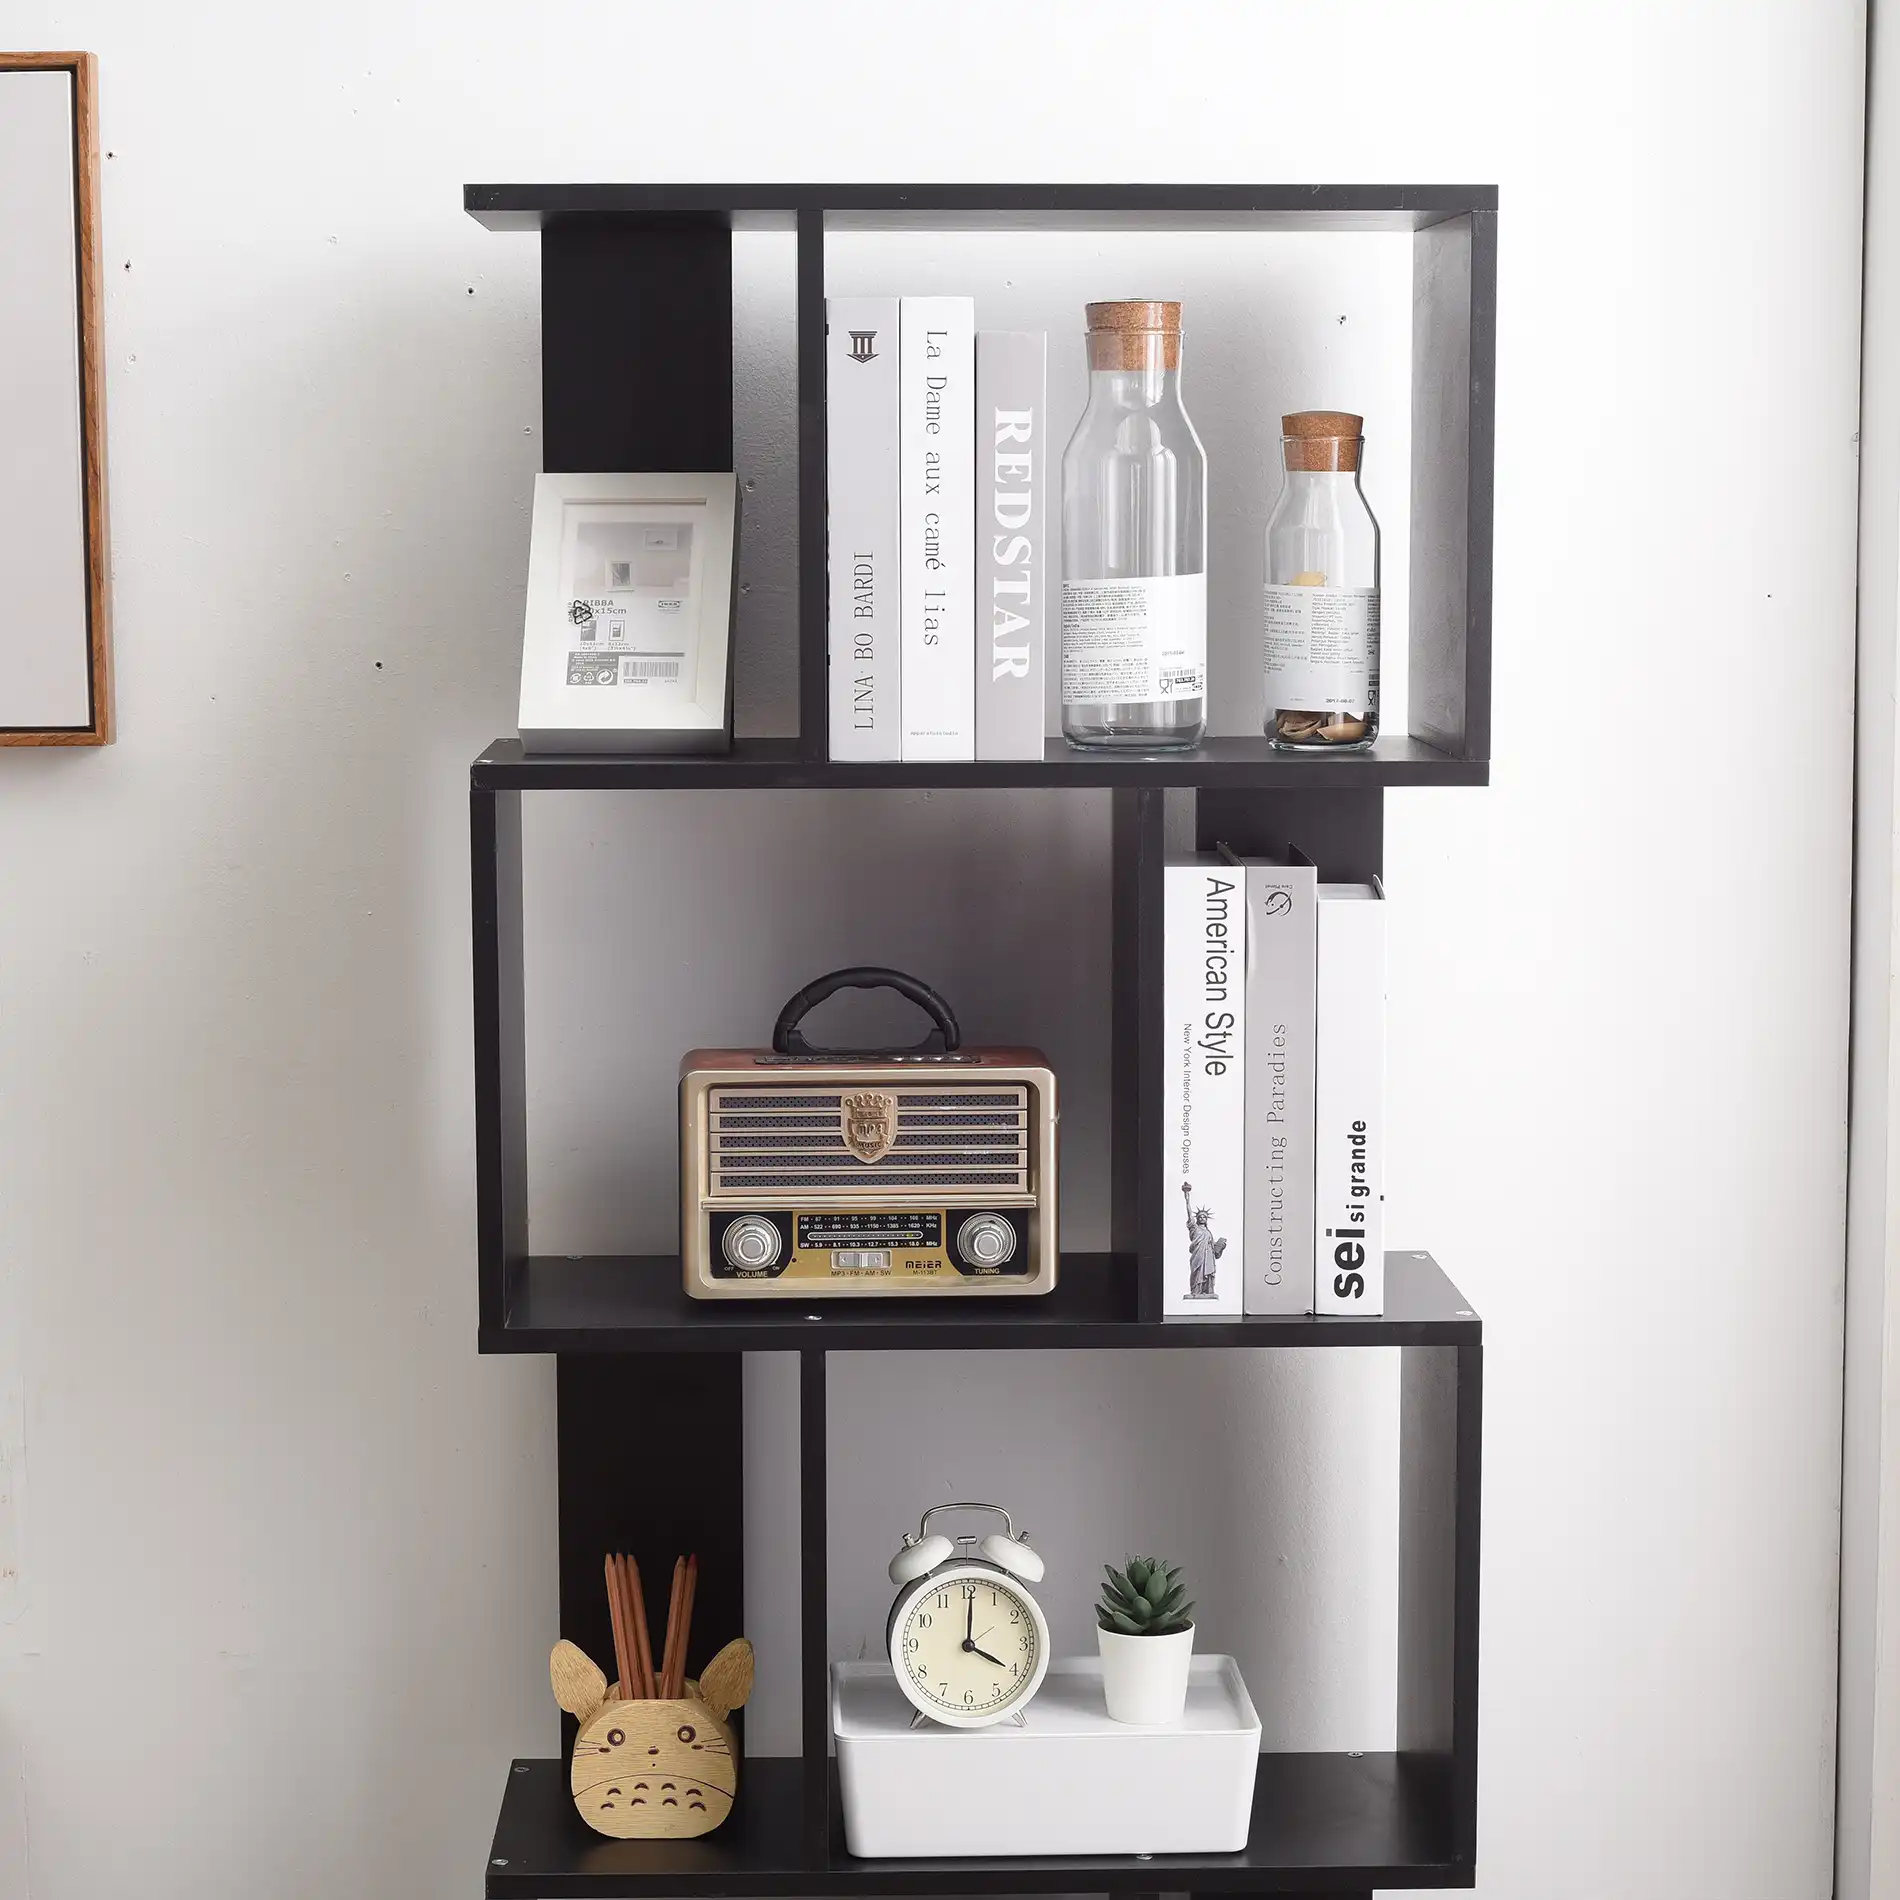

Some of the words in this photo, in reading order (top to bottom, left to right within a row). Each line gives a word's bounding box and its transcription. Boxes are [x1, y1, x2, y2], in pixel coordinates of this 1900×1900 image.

[926, 331, 948, 359] La
[926, 376, 948, 435] Dame
[925, 451, 941, 495] aux
[925, 512, 946, 570] camé
[993, 407, 1033, 683] REDSTAR
[854, 551, 873, 619] BARDI
[924, 590, 946, 646] lias
[854, 633, 873, 661] BO
[854, 676, 873, 730] LINA
[1206, 877, 1235, 1002] American
[1183, 1023, 1192, 1045] New
[1198, 1012, 1235, 1076] Style
[1183, 1046, 1192, 1068] York
[1183, 1070, 1192, 1103] Interior
[1266, 1023, 1287, 1123] Paradies
[1181, 1104, 1192, 1137] Design
[1181, 1138, 1192, 1175] Opuses
[1347, 1120, 1370, 1198] grande
[1264, 1136, 1287, 1286] Constructing
[1346, 1204, 1365, 1223] si
[1326, 1228, 1366, 1299] sei
[937, 1594, 950, 1609] 11
[961, 1585, 976, 1600] 12
[991, 1592, 998, 1606] 1
[918, 1613, 932, 1628] 10
[1010, 1610, 1019, 1625] 2
[909, 1638, 919, 1653] 9
[1019, 1637, 1028, 1651] 3
[917, 1664, 928, 1679] 8
[1009, 1662, 1019, 1676] 4
[938, 1682, 948, 1697] 7
[964, 1690, 974, 1705] 6
[991, 1683, 1001, 1697] 5
